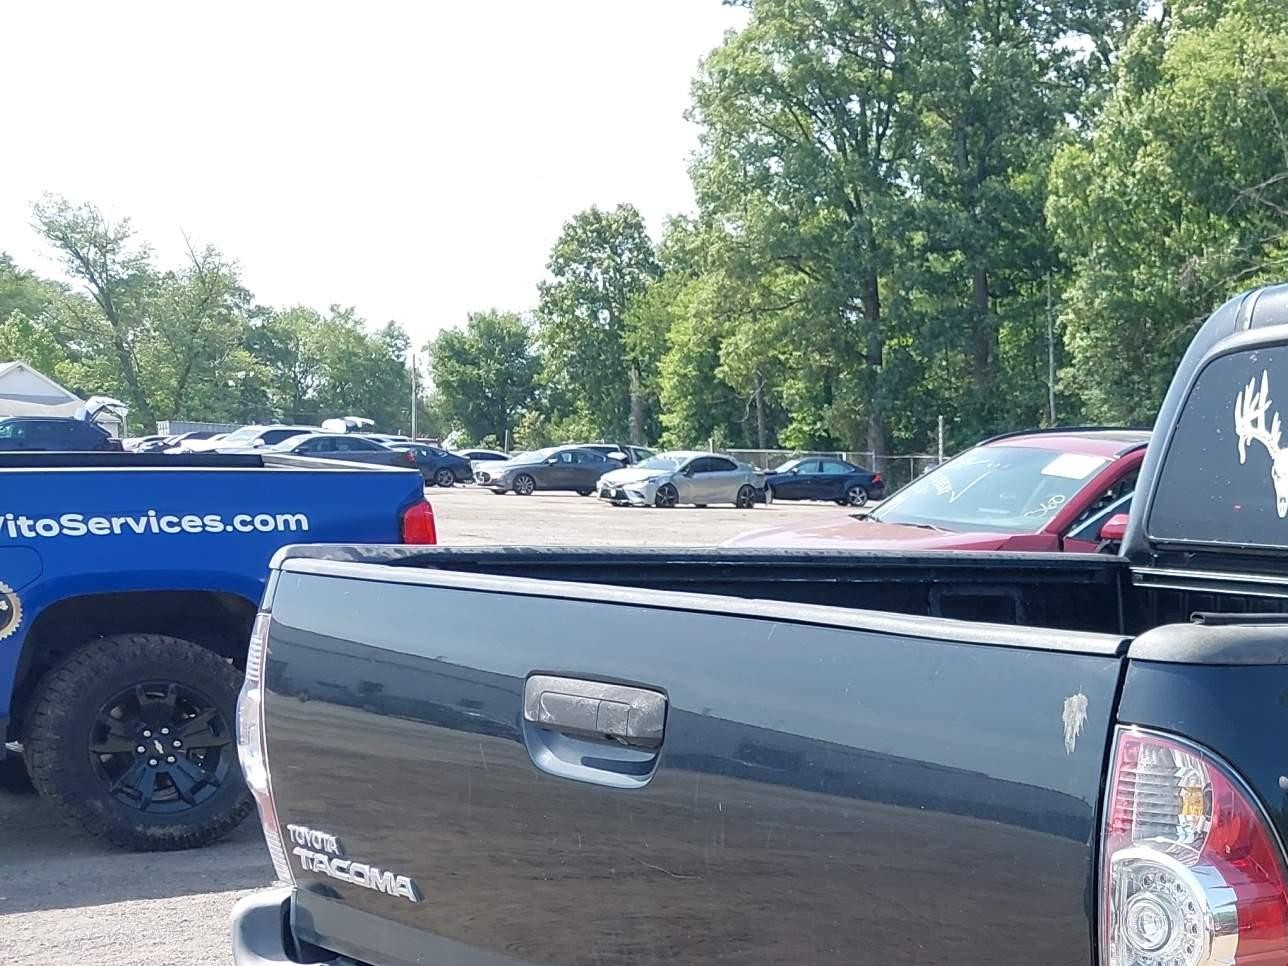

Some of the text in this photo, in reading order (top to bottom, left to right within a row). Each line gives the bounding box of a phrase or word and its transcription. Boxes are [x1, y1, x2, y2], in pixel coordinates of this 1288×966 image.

[0, 510, 309, 538] itoServices.com
[286, 824, 344, 856] TOYOTA
[293, 846, 424, 903] TACOMA
